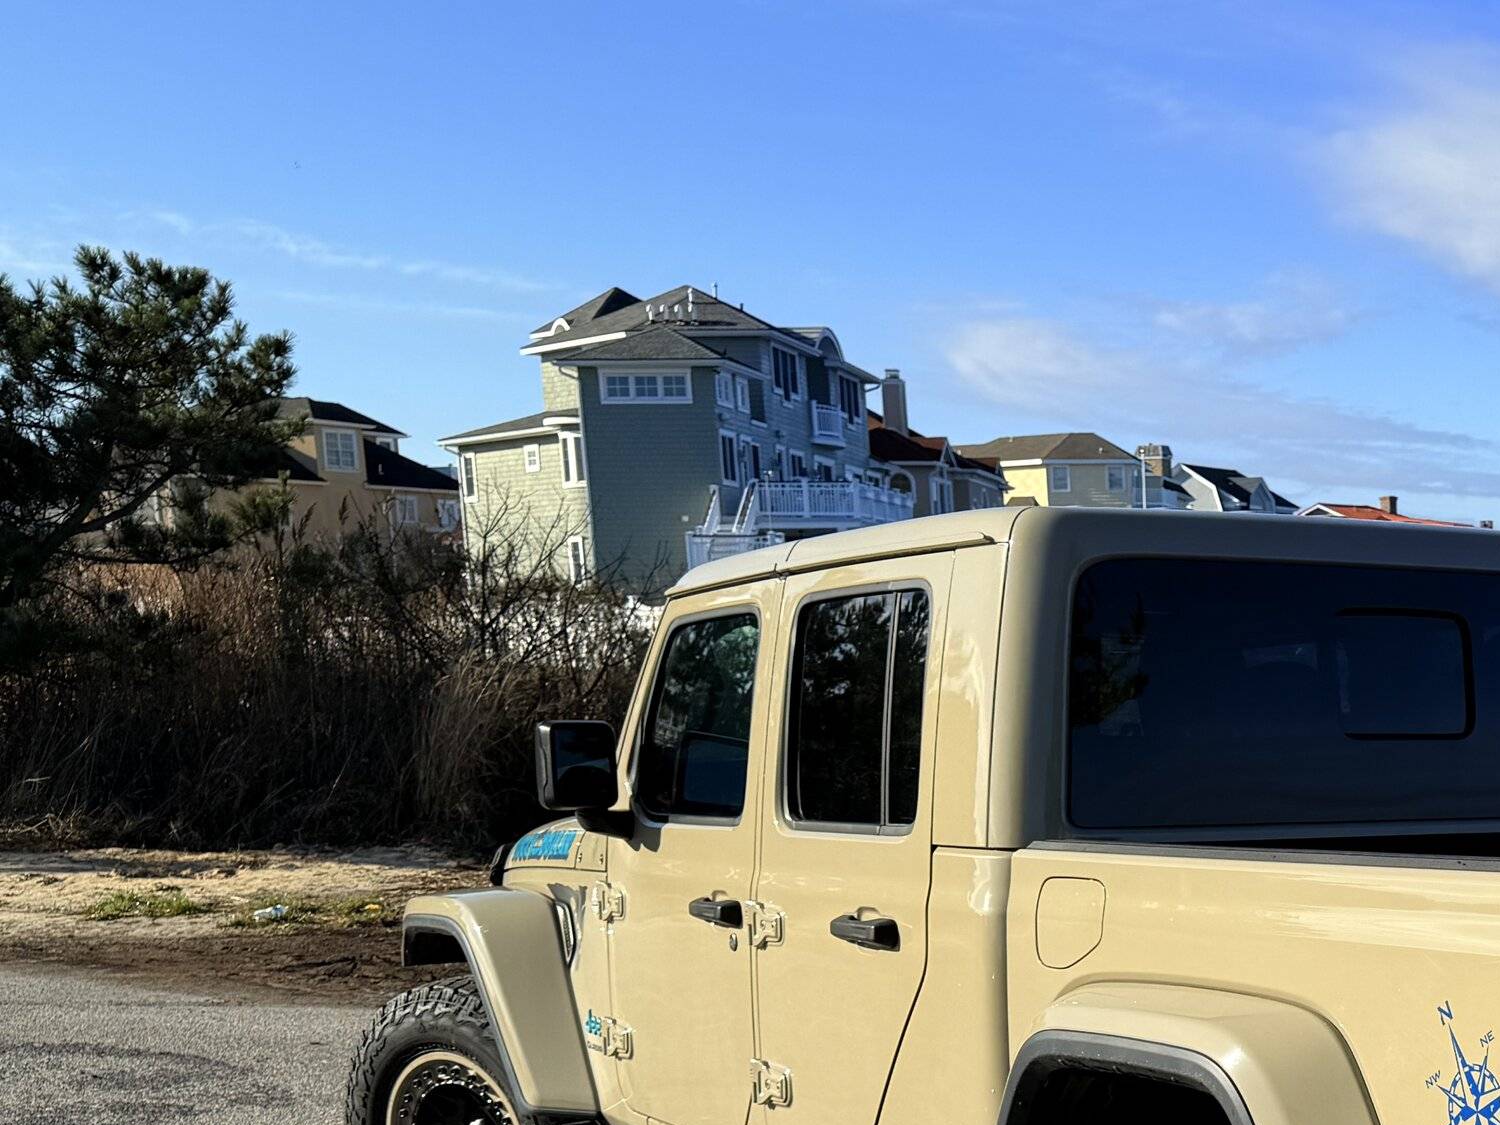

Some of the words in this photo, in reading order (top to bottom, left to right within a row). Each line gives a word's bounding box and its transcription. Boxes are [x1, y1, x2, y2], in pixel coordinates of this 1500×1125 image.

[1437, 1000, 1454, 1025] N
[1479, 1030, 1495, 1047] NE
[1425, 1070, 1441, 1089] NW
